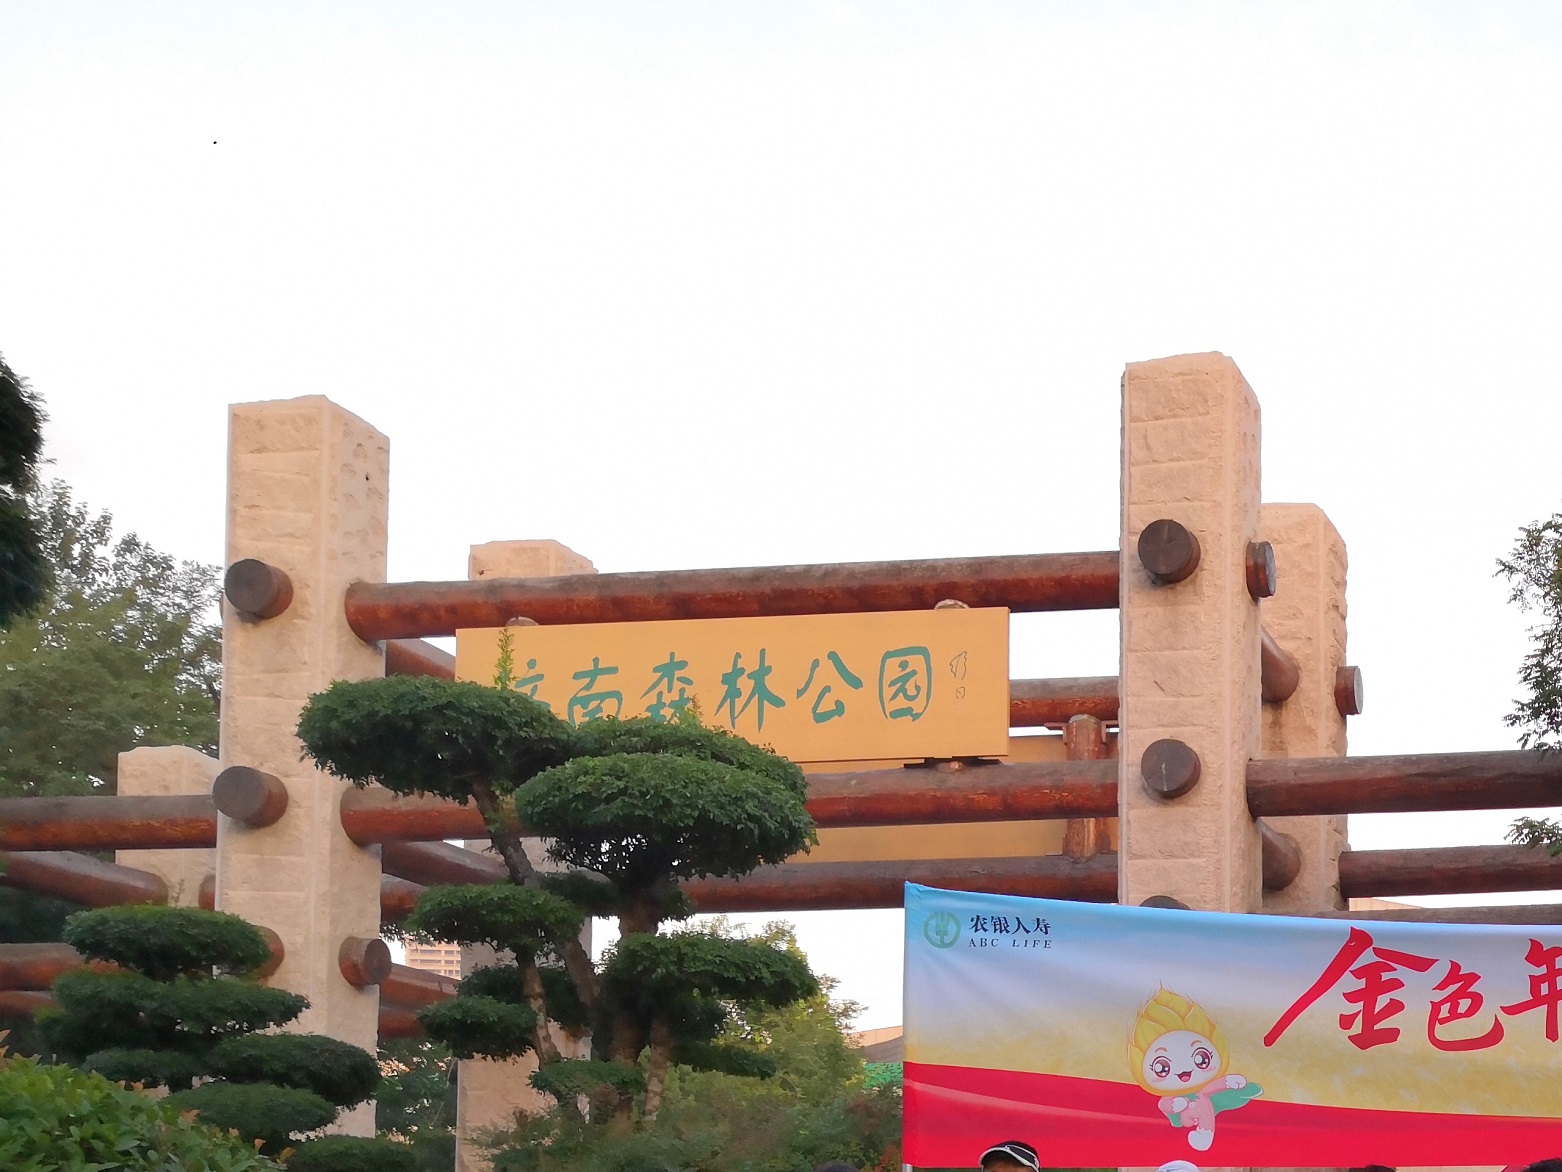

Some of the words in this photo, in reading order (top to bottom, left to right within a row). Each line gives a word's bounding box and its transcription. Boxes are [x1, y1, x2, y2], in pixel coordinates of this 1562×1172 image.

[968, 915, 1051, 935] 农银人寿
[968, 937, 999, 948] ABC
[1012, 939, 1052, 949] LIFE
